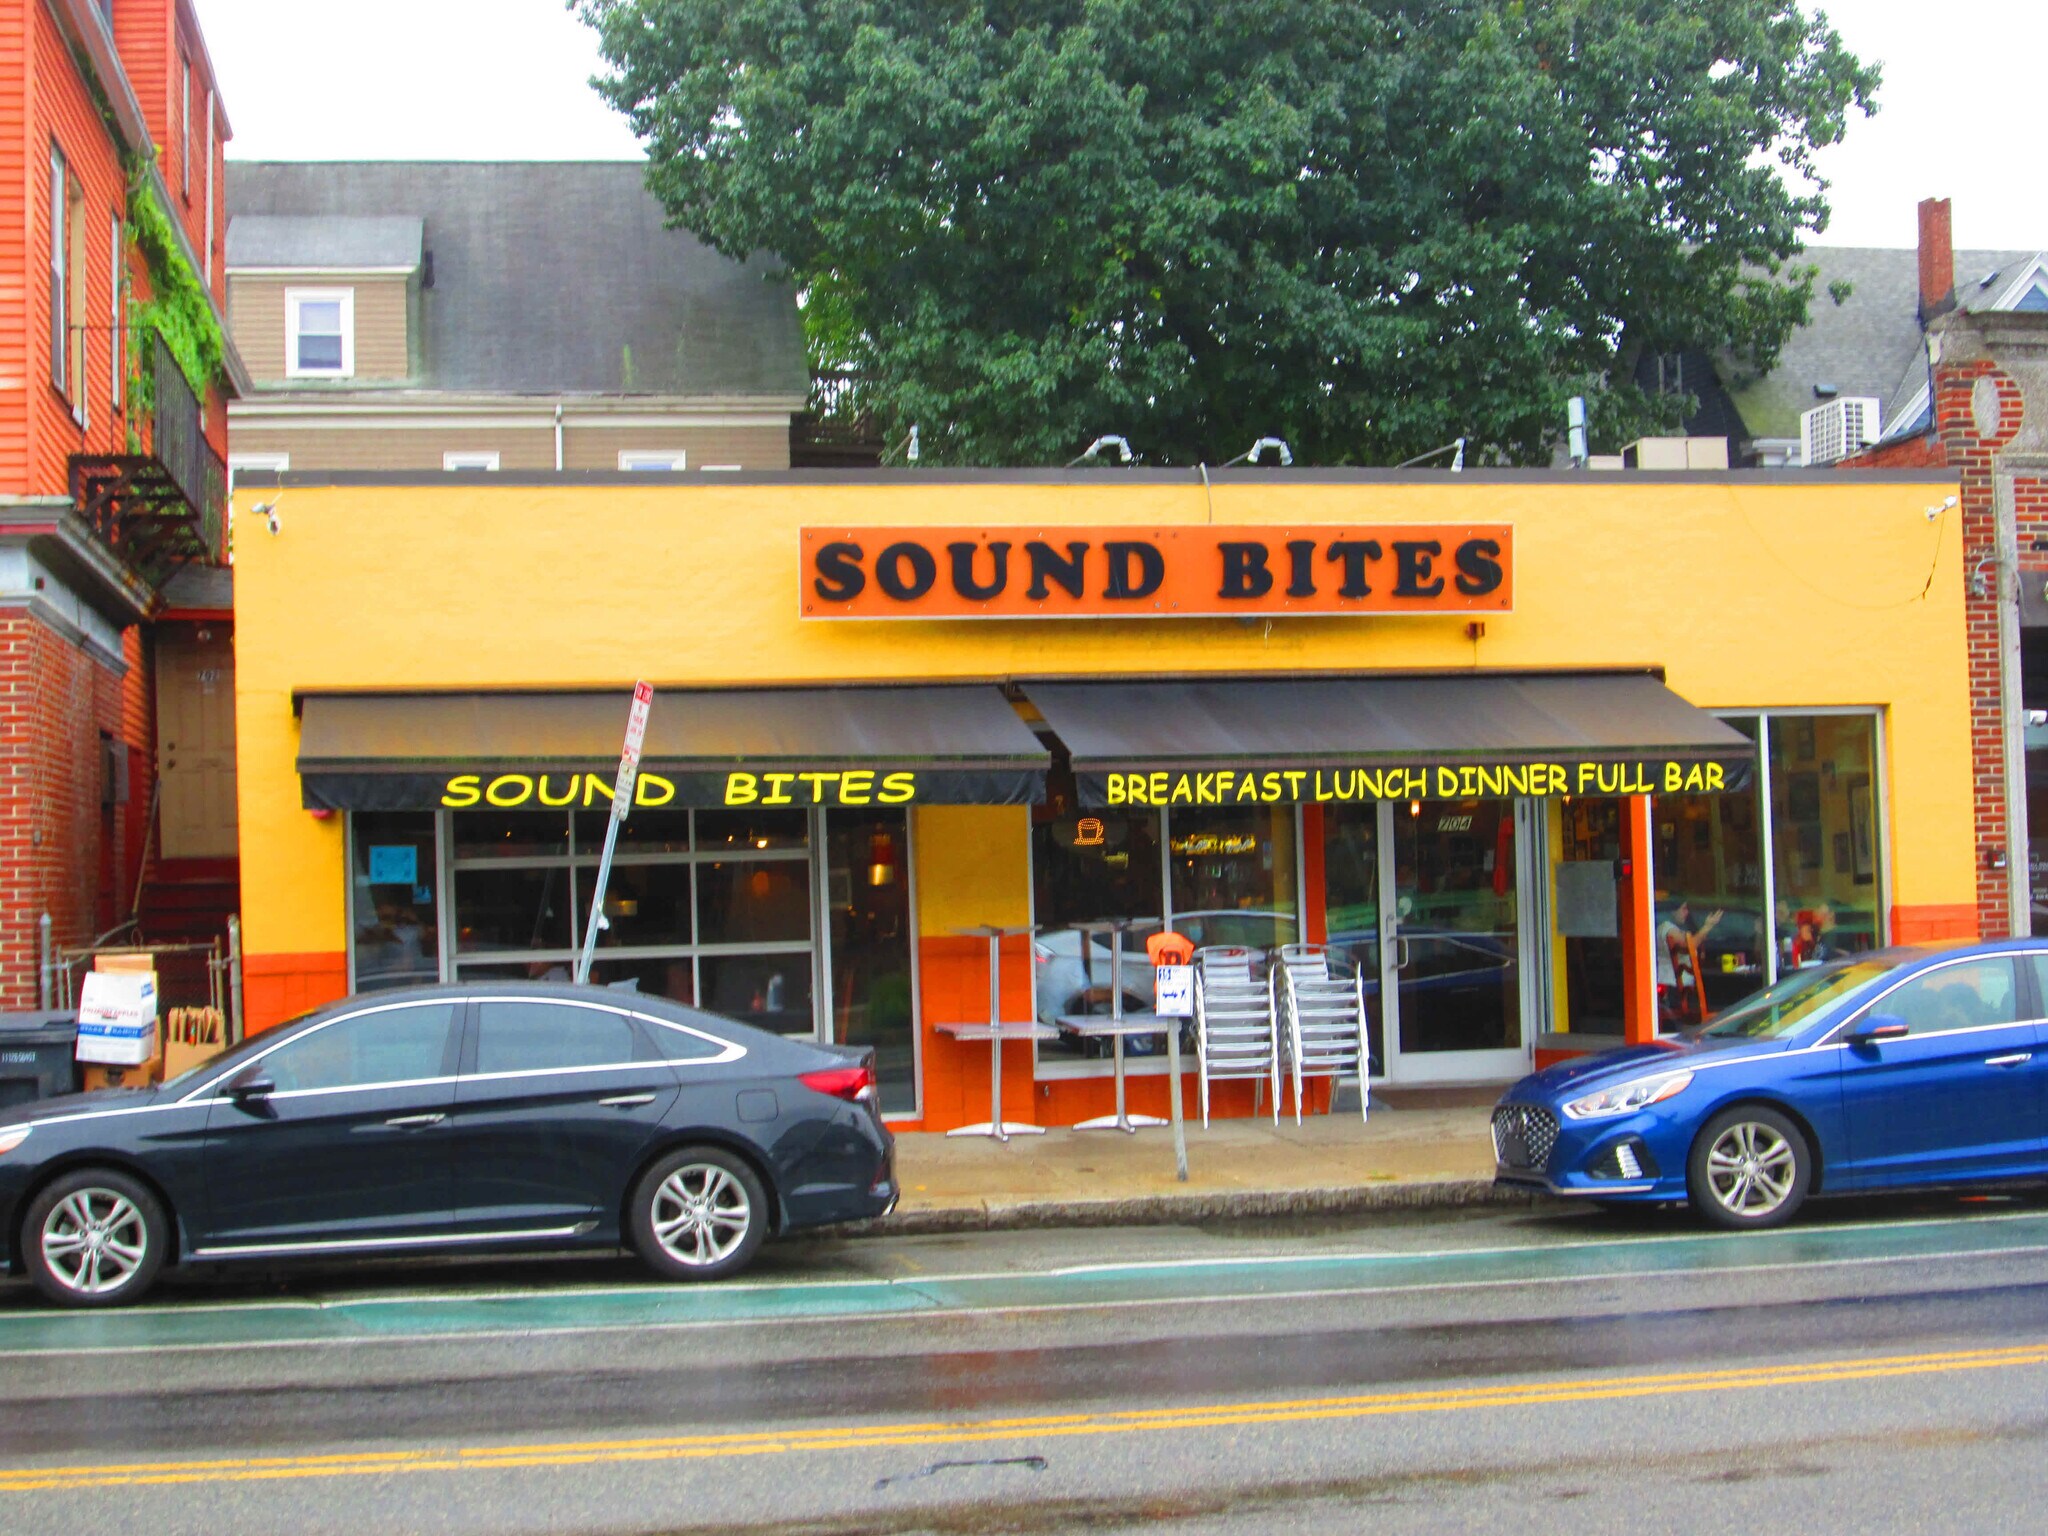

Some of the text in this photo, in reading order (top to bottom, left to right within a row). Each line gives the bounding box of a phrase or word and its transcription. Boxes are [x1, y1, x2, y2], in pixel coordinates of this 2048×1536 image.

[814, 538, 1504, 602] SOUND BITES
[441, 773, 676, 807] SOUND
[724, 770, 915, 805] BITES
[1107, 761, 1725, 805] BREAKFAST LUNCH DINNER FULL BAR
[1438, 816, 1472, 831] 704
